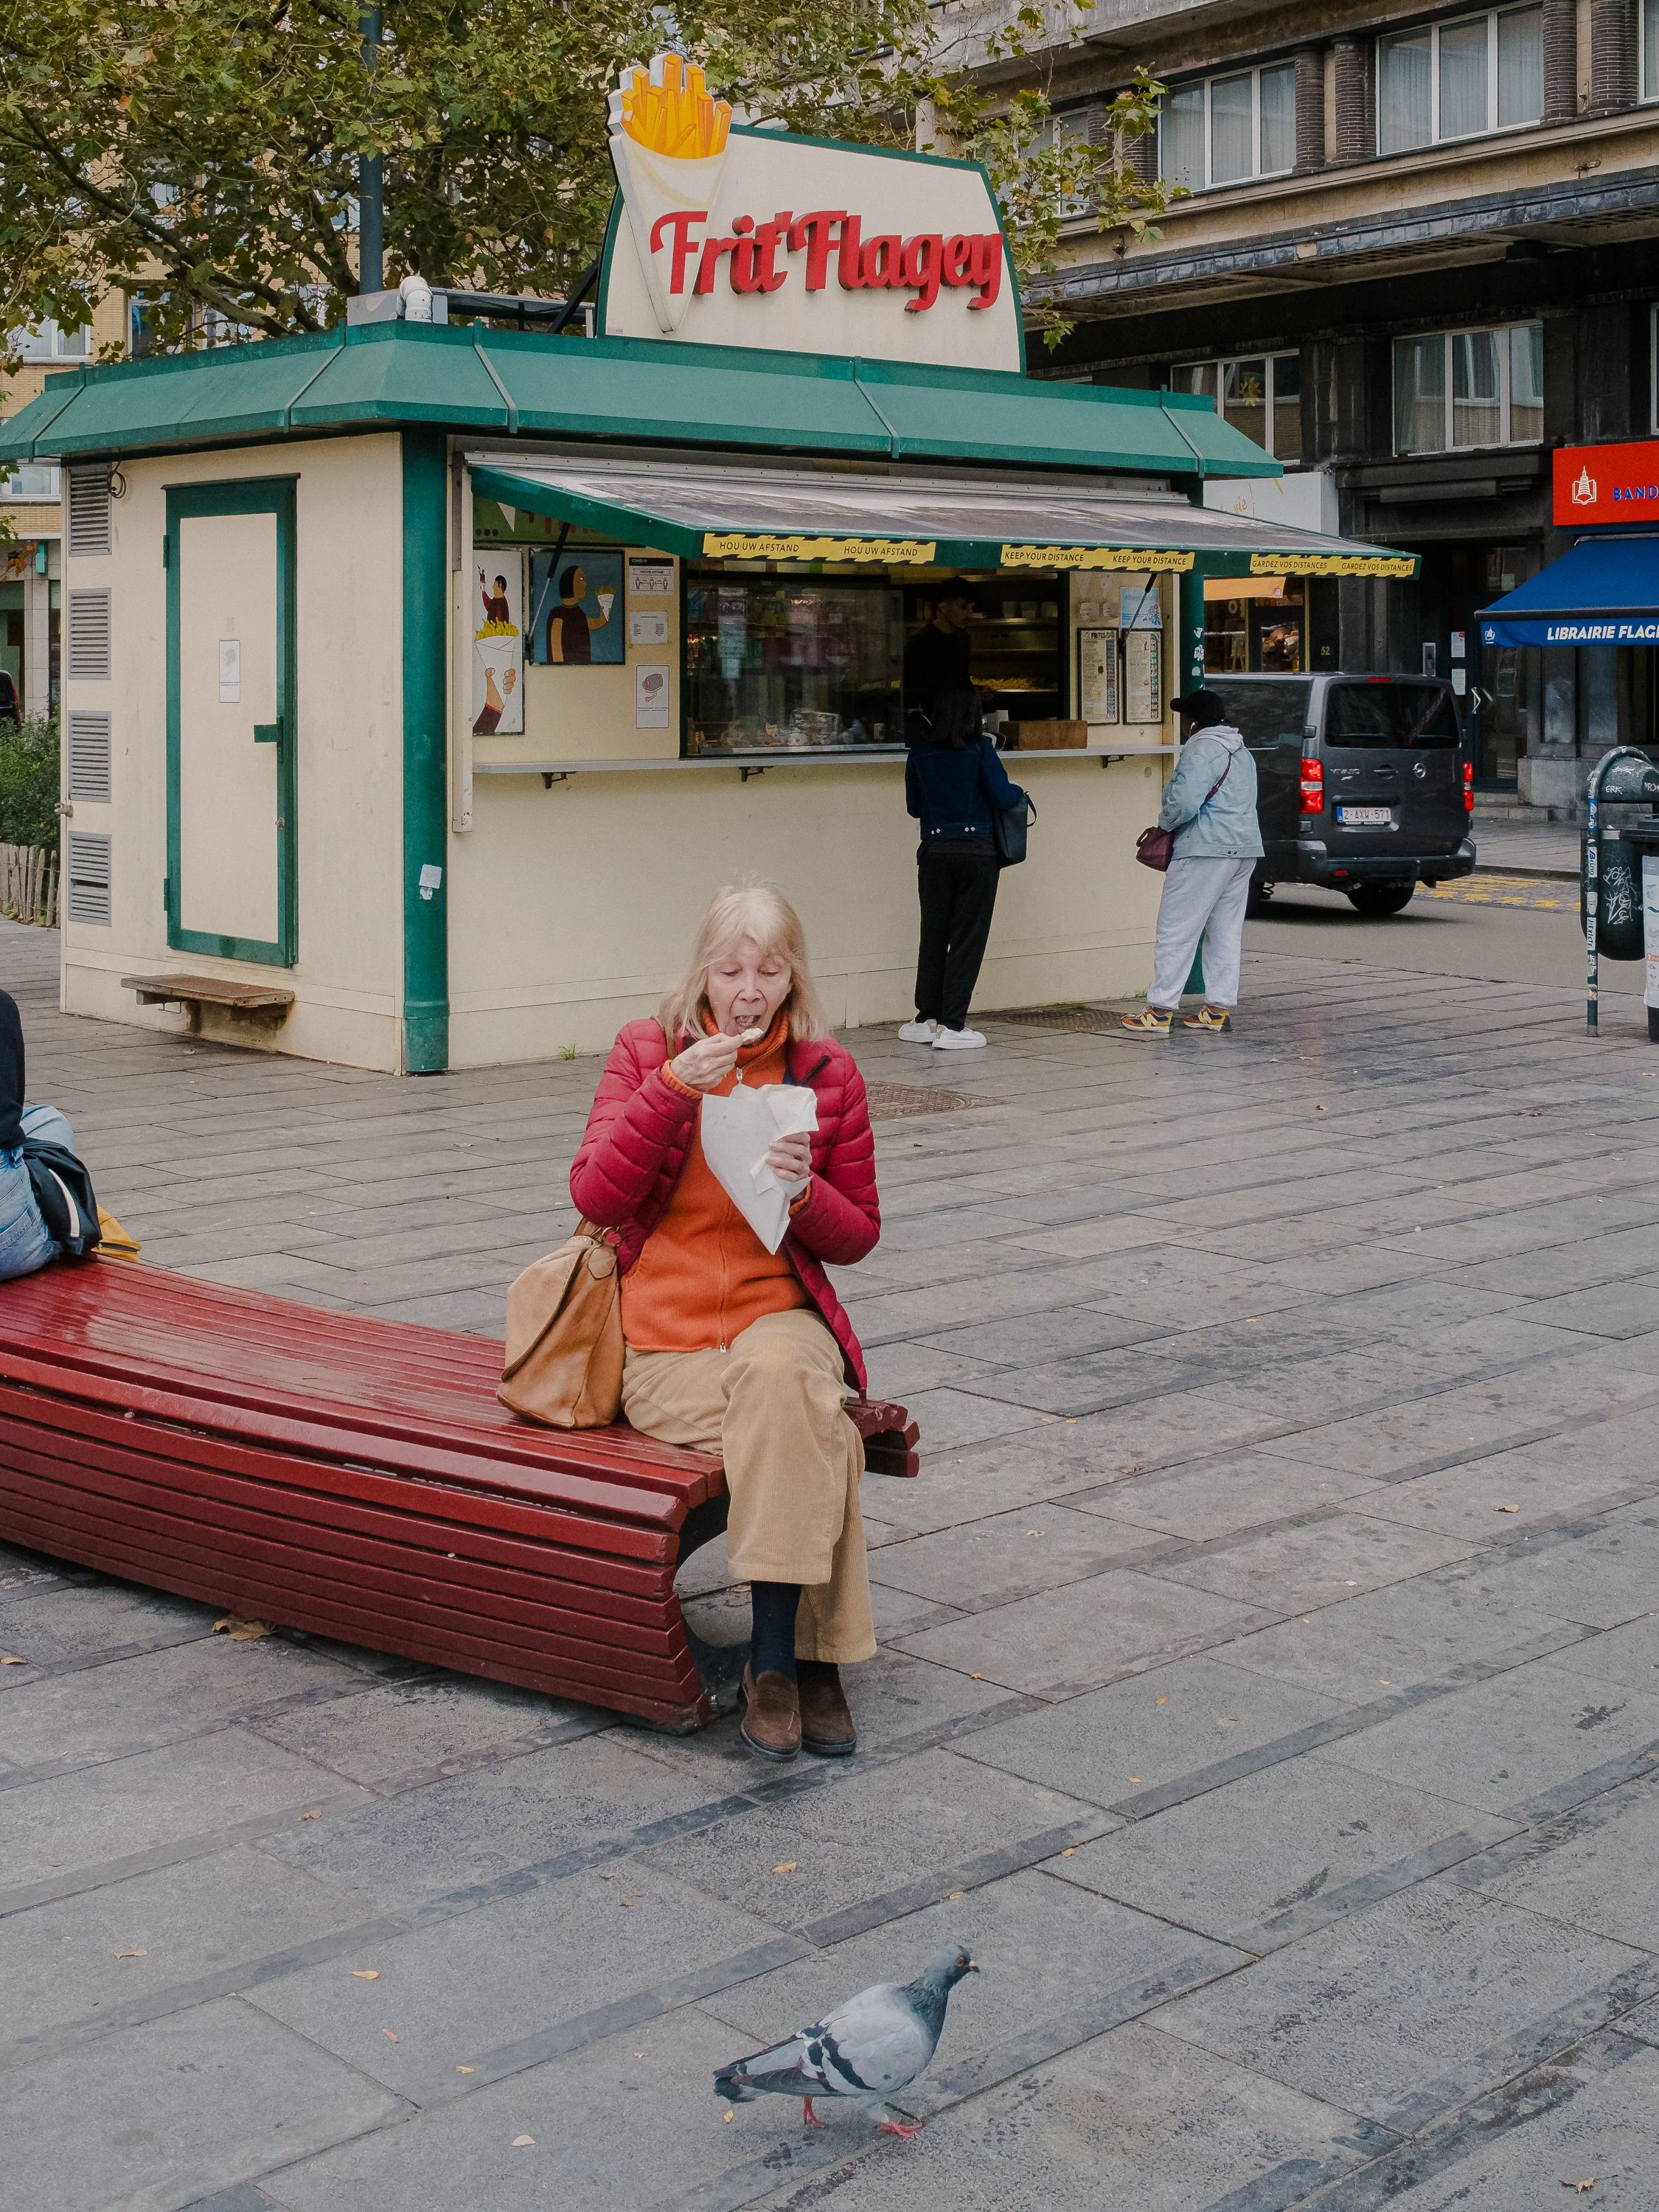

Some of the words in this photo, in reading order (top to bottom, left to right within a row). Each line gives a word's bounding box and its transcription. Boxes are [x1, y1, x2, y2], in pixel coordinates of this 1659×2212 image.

[720, 542, 740, 550] HOU
[742, 543, 757, 551] UW
[759, 543, 799, 552] AFSTAND
[844, 546, 863, 554] HOU
[865, 546, 879, 555] UW
[880, 547, 918, 556] AFSTAND
[1004, 552, 1024, 560] KEEP
[1026, 552, 1047, 560] YOUR
[1048, 553, 1084, 562] DISTANCE
[1132, 556, 1152, 564] YOUR
[1153, 557, 1186, 565] DISTANCE
[1293, 561, 1327, 569] DISTANCES
[1380, 563, 1413, 571] DISTANCES
[1547, 626, 1615, 641] LIBRAIRIE
[1321, 646, 1330, 655] 52
[1344, 810, 1389, 819] 2-AXW-571
